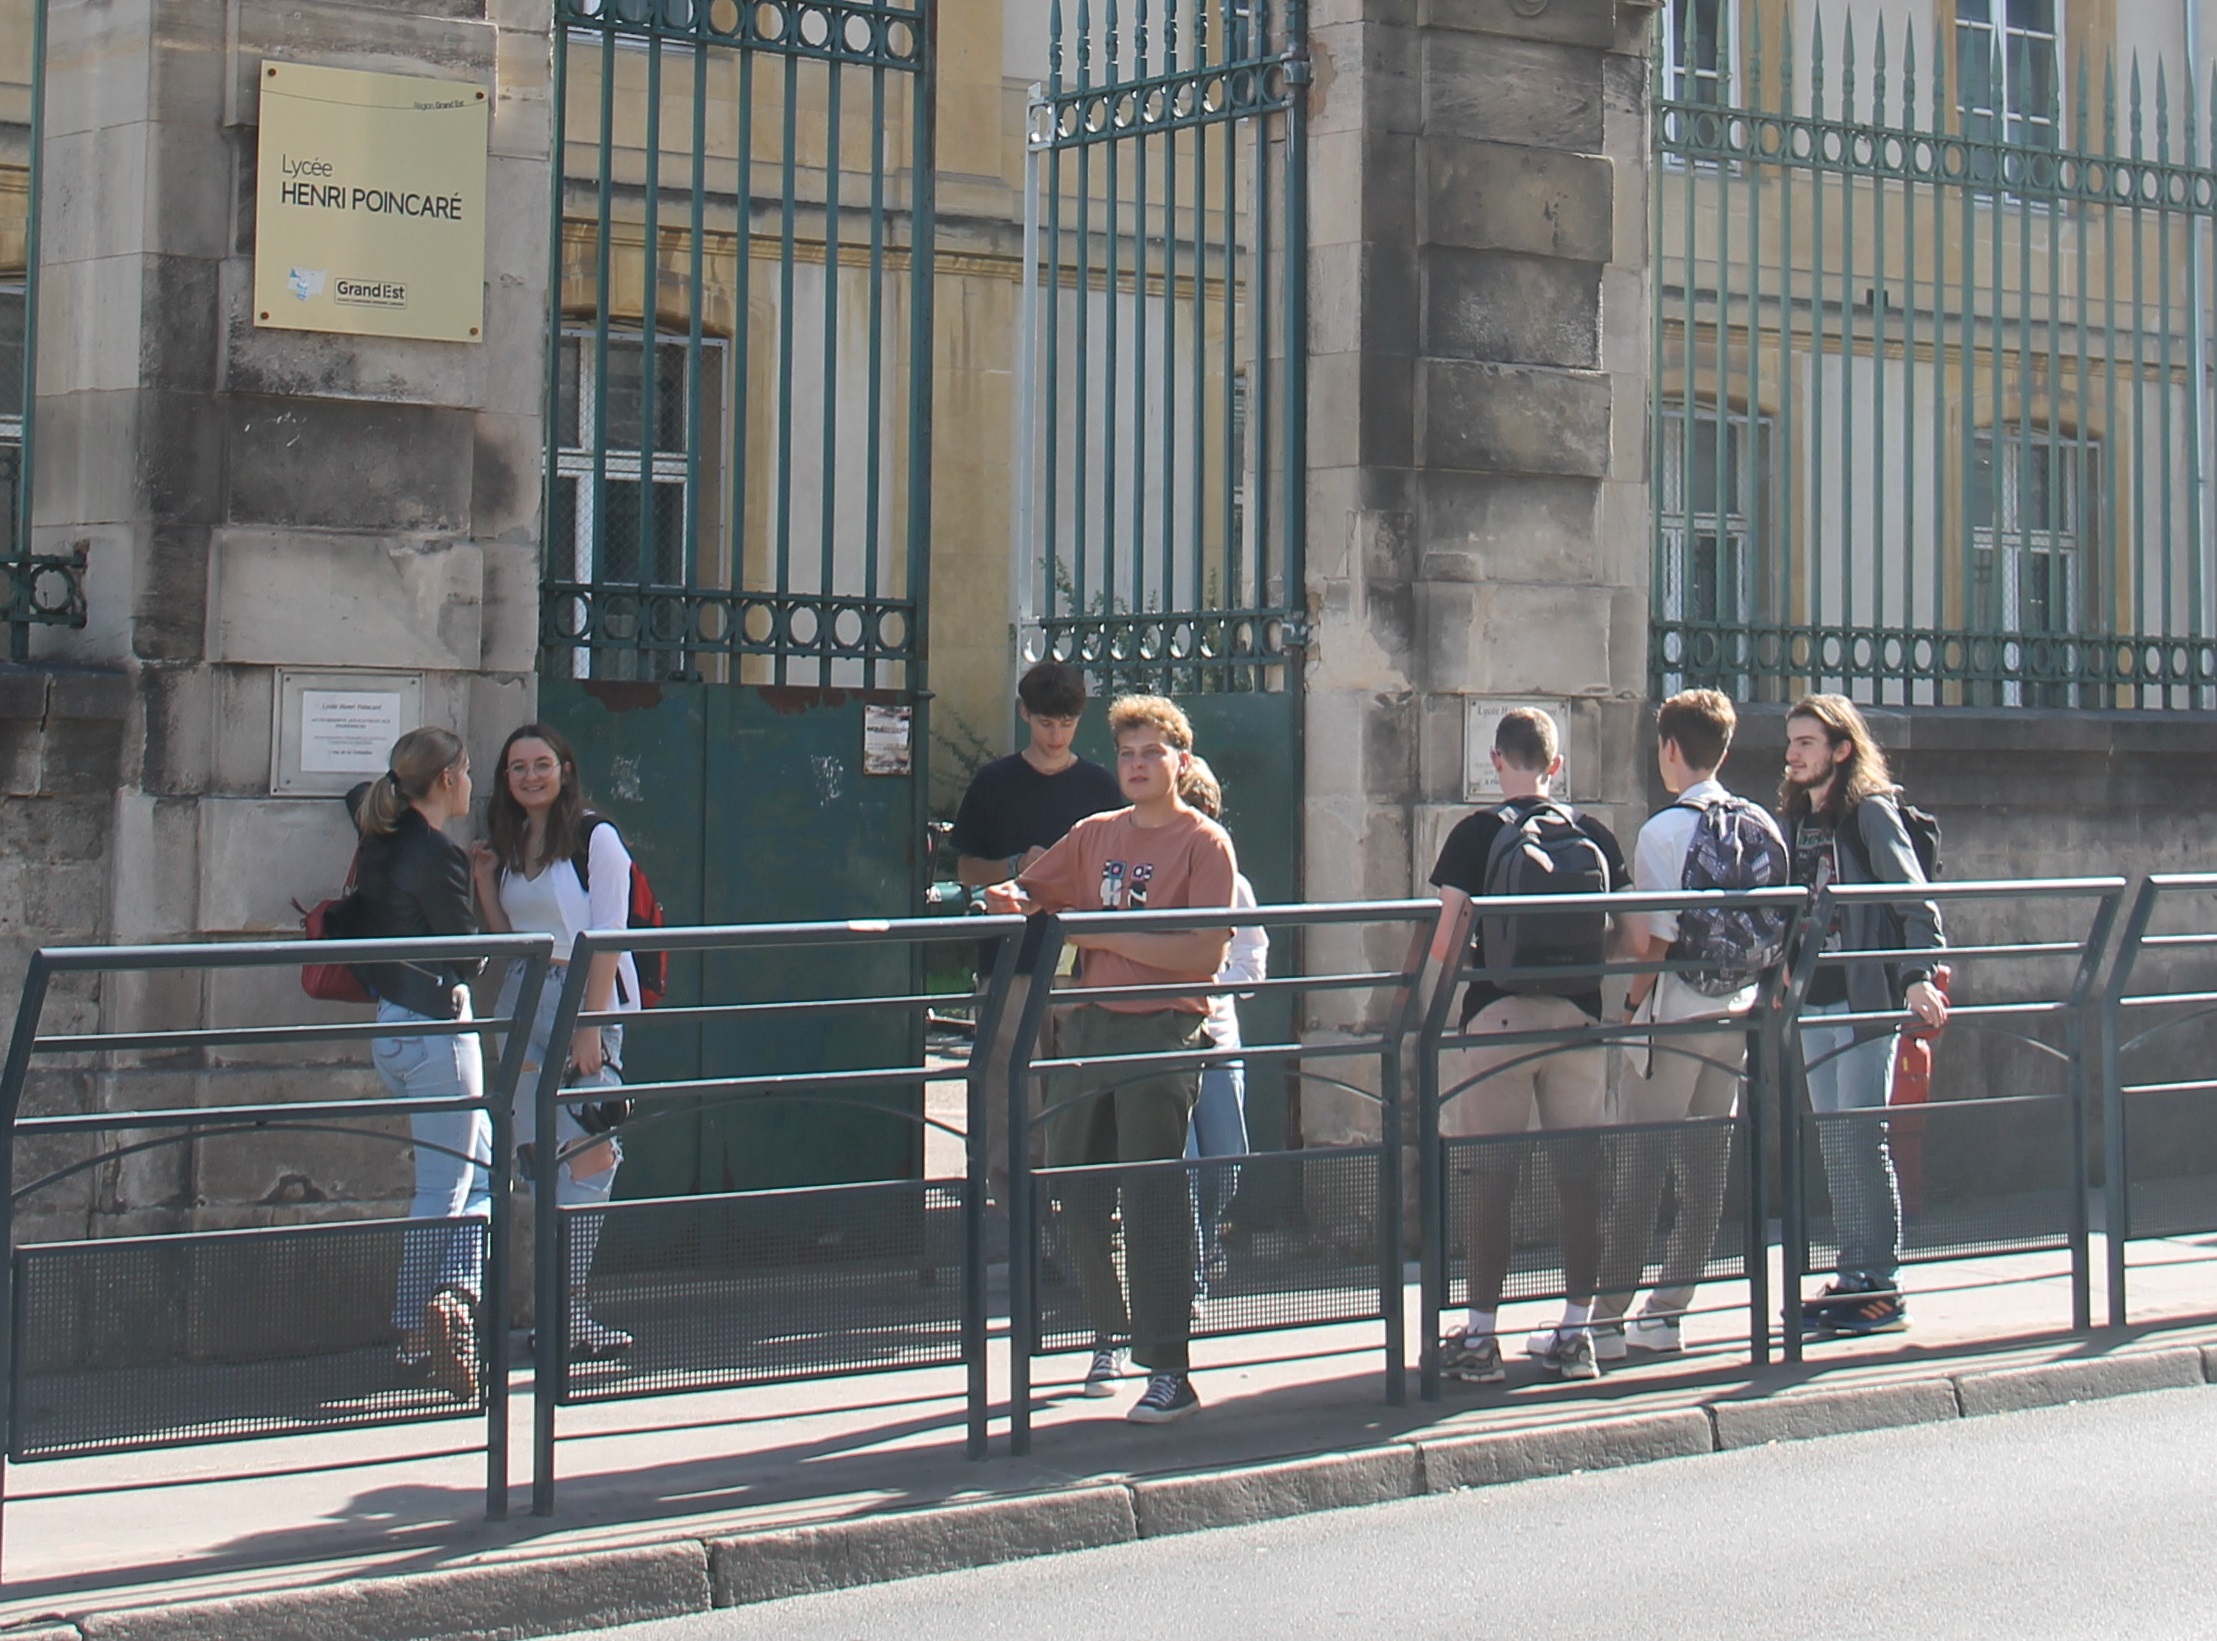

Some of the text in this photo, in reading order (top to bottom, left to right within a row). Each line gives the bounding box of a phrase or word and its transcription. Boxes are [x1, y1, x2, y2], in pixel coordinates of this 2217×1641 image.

[282, 153, 333, 179] Lycée
[281, 181, 463, 220] HENRI POINCARÉ
